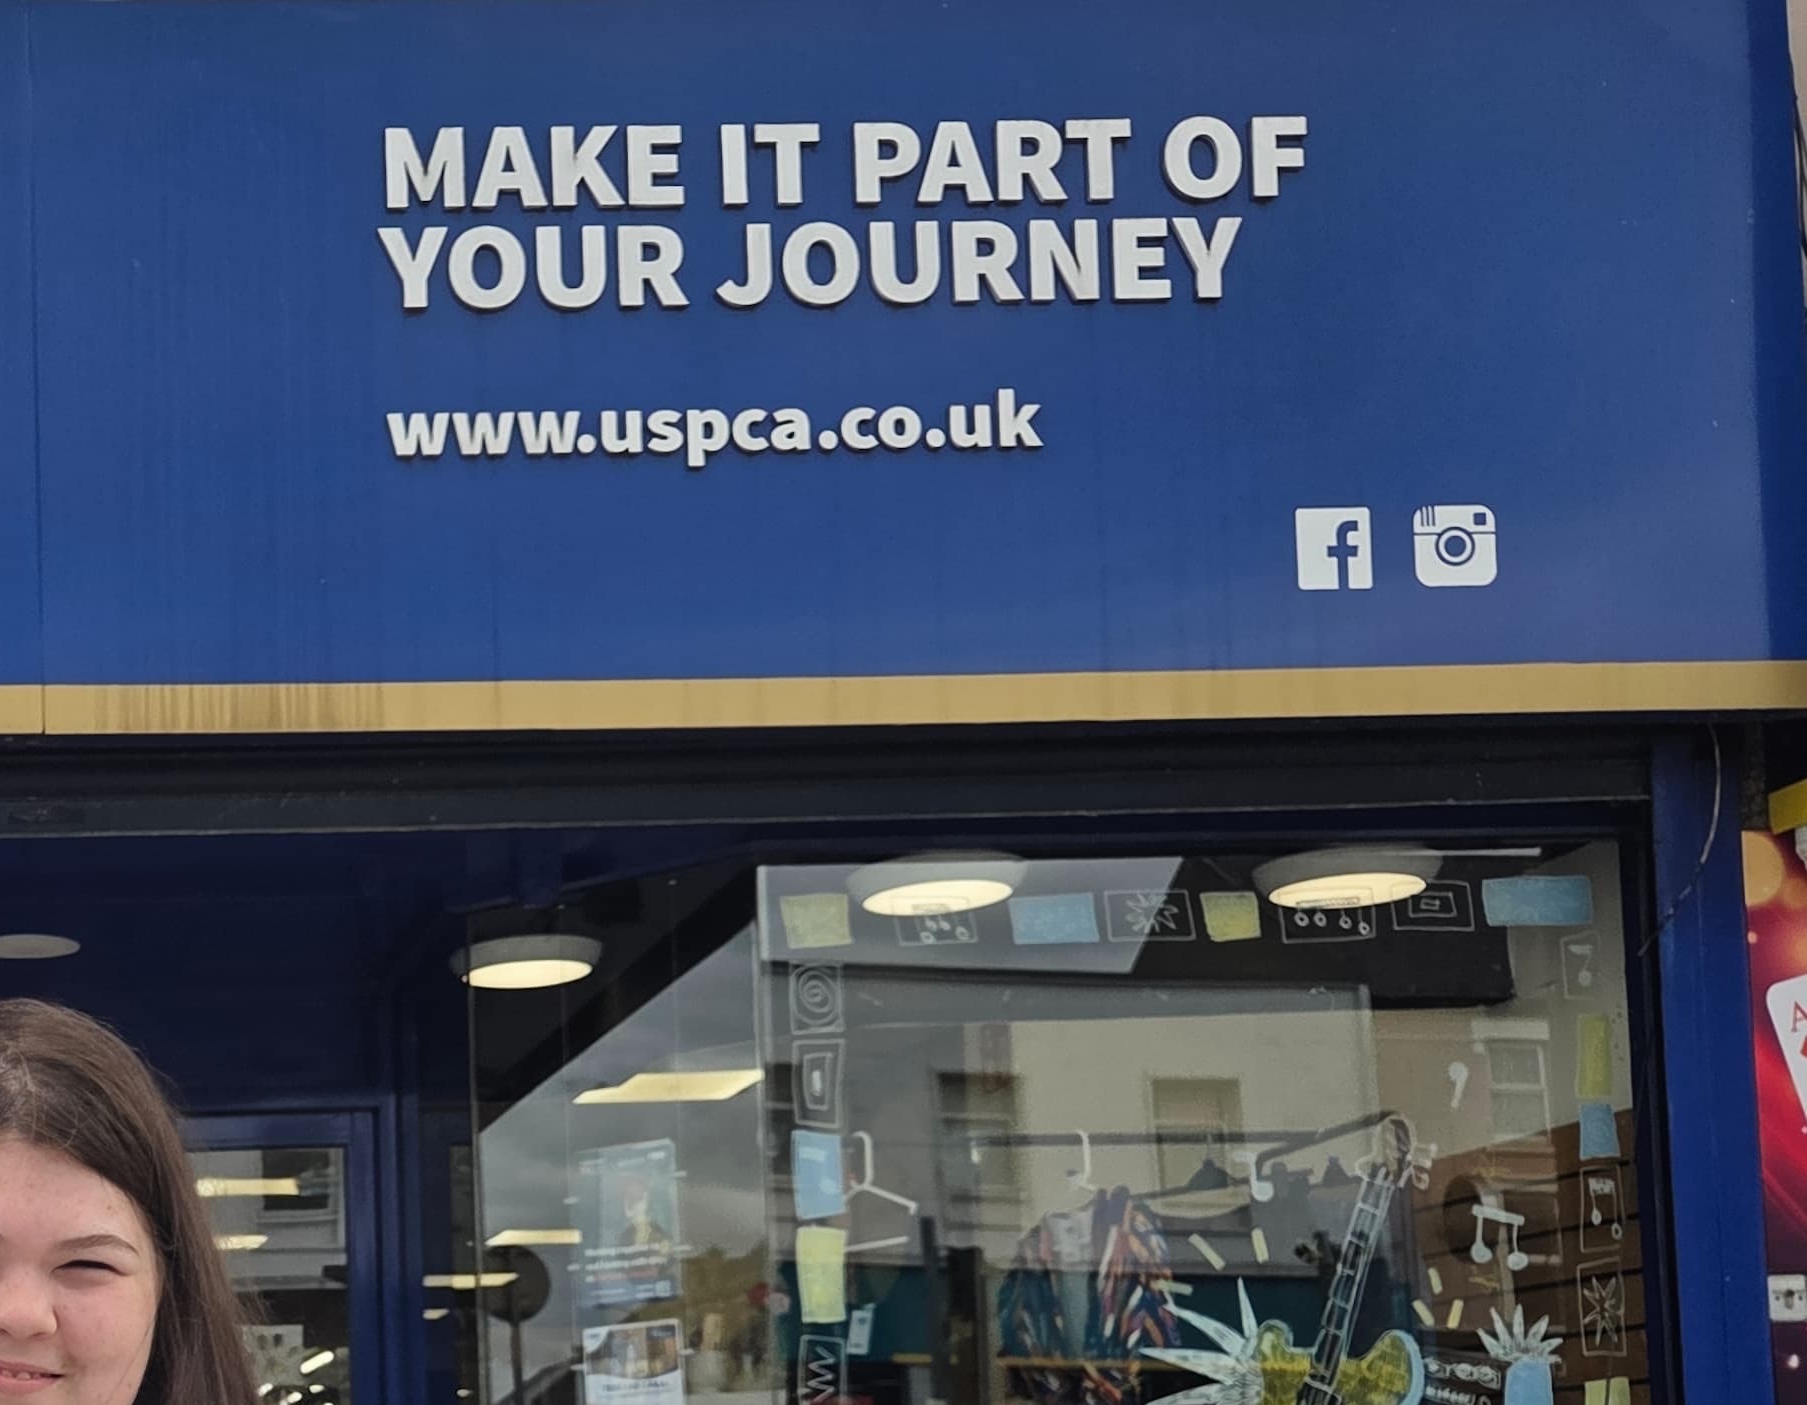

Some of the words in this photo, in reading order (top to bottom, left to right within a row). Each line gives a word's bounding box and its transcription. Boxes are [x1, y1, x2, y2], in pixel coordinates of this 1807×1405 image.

[384, 125, 688, 210] MAKE
[720, 122, 821, 207] IT
[851, 118, 1132, 206] PART
[1161, 115, 1308, 201] OF
[378, 222, 690, 310] YOUR
[714, 215, 1243, 308] JOURNEY
[385, 388, 1044, 468] www.uspca.co.uk
